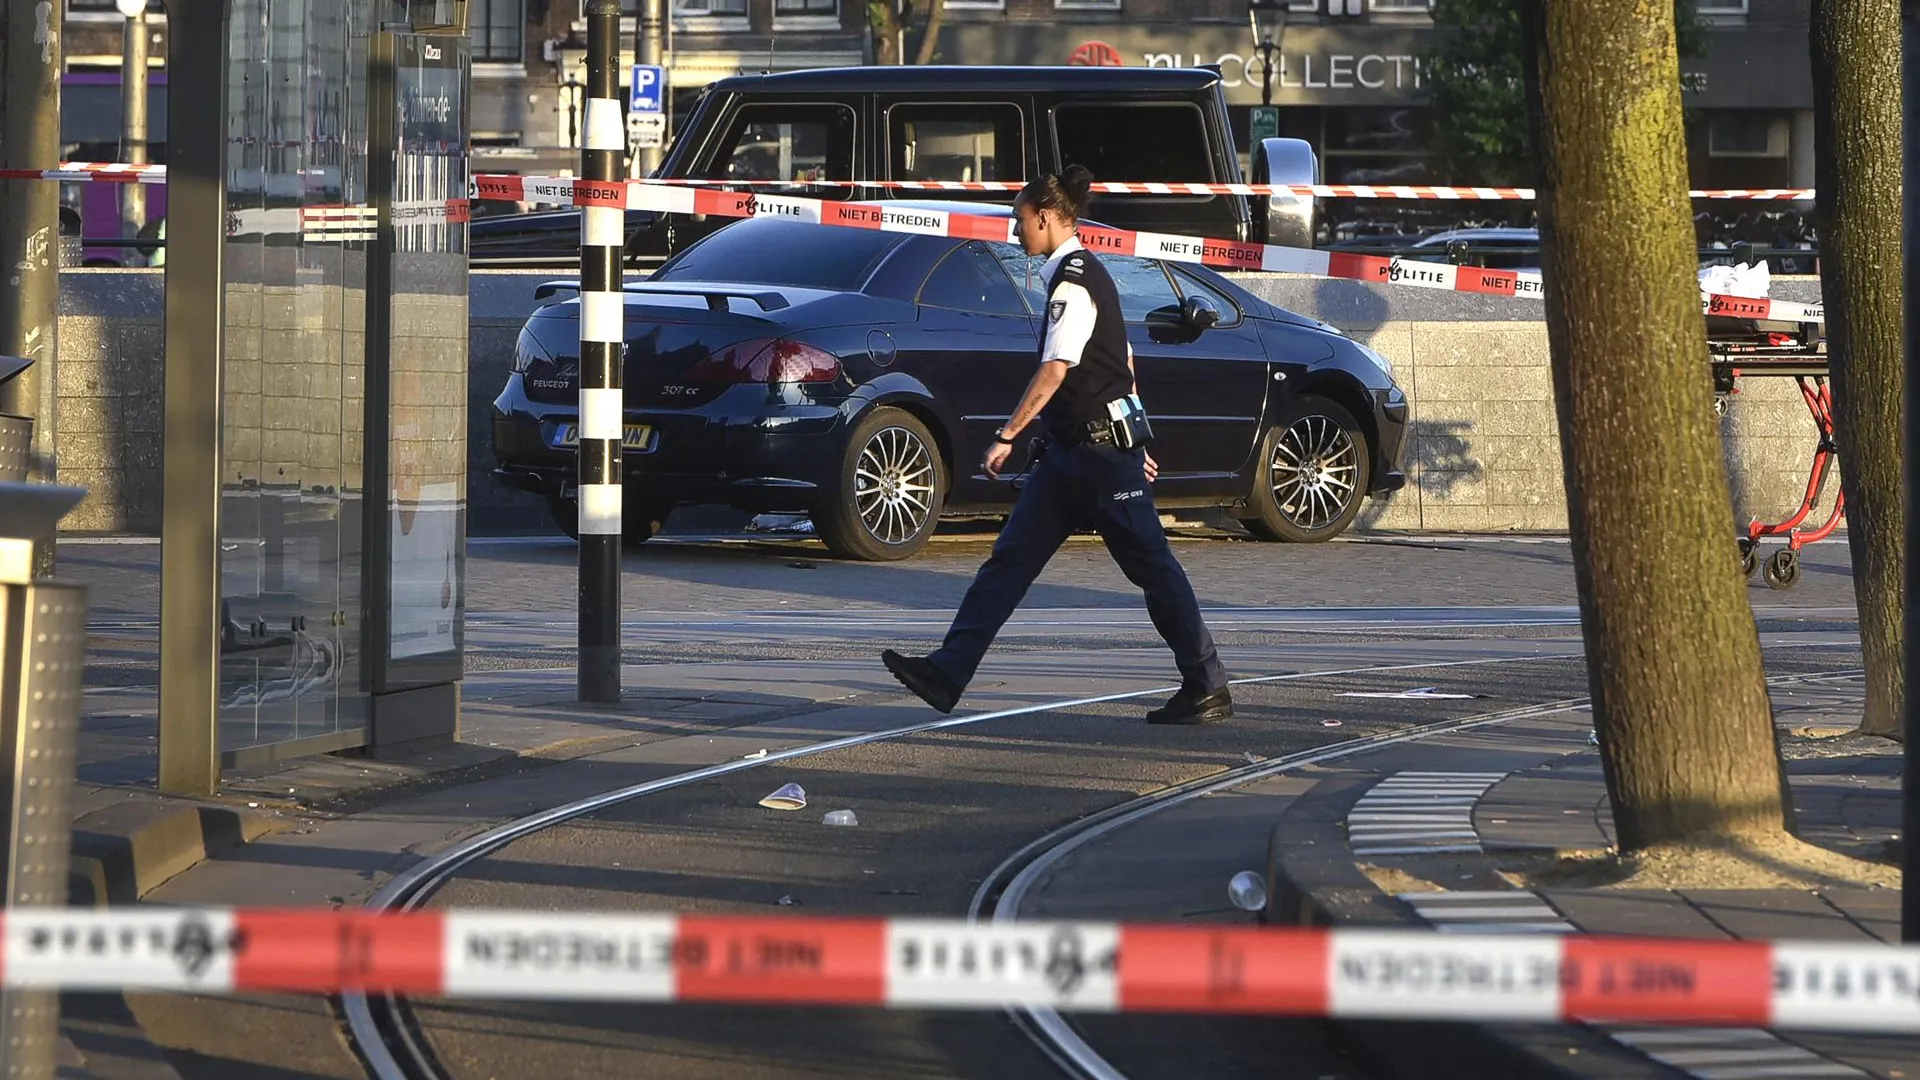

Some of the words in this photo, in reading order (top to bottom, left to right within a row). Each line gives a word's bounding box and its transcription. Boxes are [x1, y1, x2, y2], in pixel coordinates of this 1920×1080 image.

[638, 69, 655, 94] P
[1215, 53, 1475, 89] COLLECTI
[535, 185, 557, 197] NIET
[560, 186, 619, 201] BETREDEN
[838, 207, 868, 221] NIET
[870, 211, 941, 228] BETREDEN
[1076, 231, 1122, 248] LITIE
[1159, 241, 1190, 255] NIET
[1192, 245, 1263, 263] BETREDEN
[1379, 259, 1444, 283] POLITIE
[1481, 276, 1511, 290] NIET
[533, 379, 569, 389] PEUGEOT
[661, 385, 684, 396] 307
[464, 929, 711, 972] BETREDEN
[726, 935, 825, 972] NIET
